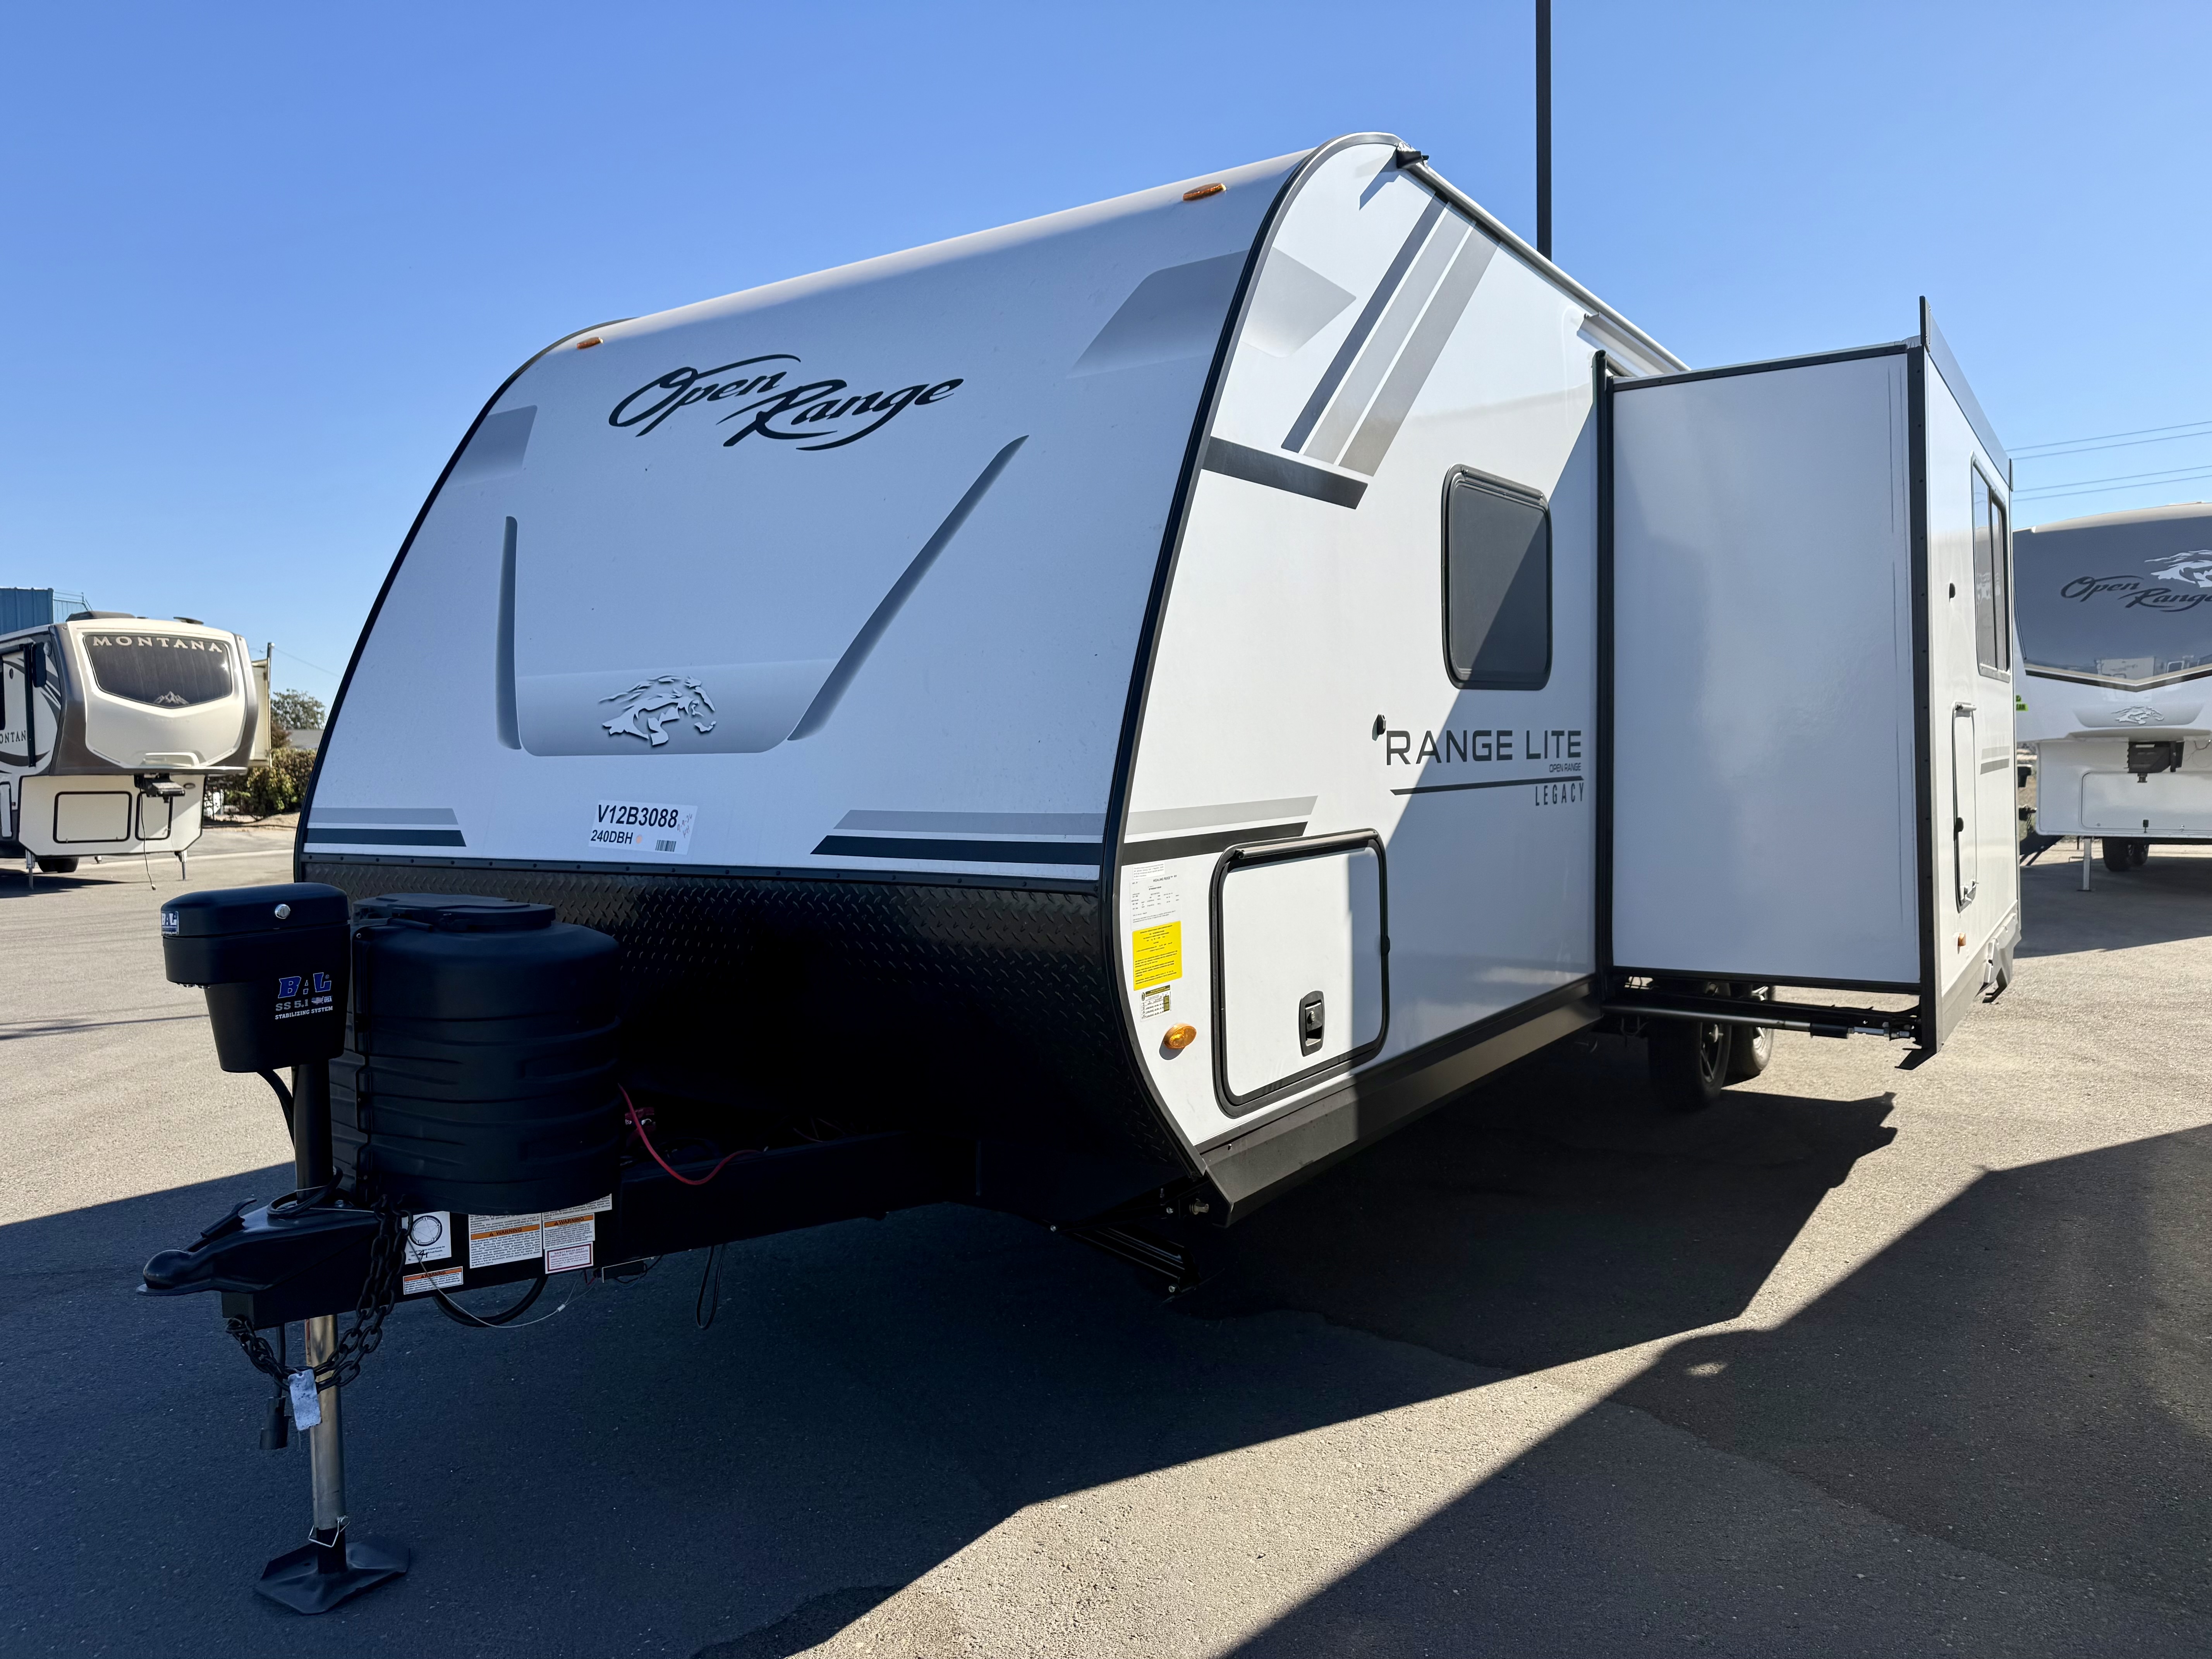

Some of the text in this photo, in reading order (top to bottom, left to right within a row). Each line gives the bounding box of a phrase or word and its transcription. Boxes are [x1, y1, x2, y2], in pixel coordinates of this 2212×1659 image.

[609, 354, 801, 437] Open
[716, 379, 964, 451] Range
[2061, 575, 2144, 602] Open
[93, 636, 222, 653] MONTANA
[0, 730, 26, 744] ONTAN
[1386, 730, 1581, 765] RANGE LITE
[1549, 763, 1581, 773] OPEN RANGE
[1535, 783, 1584, 806] LEGACY
[598, 804, 678, 828] V12B3088
[591, 830, 633, 844] 240DBH
[275, 999, 309, 1011] SS 5.1
[275, 1010, 310, 1020] STABILIZING
[560, 1216, 584, 1225] WARNING
[496, 1227, 522, 1236] WARNING
